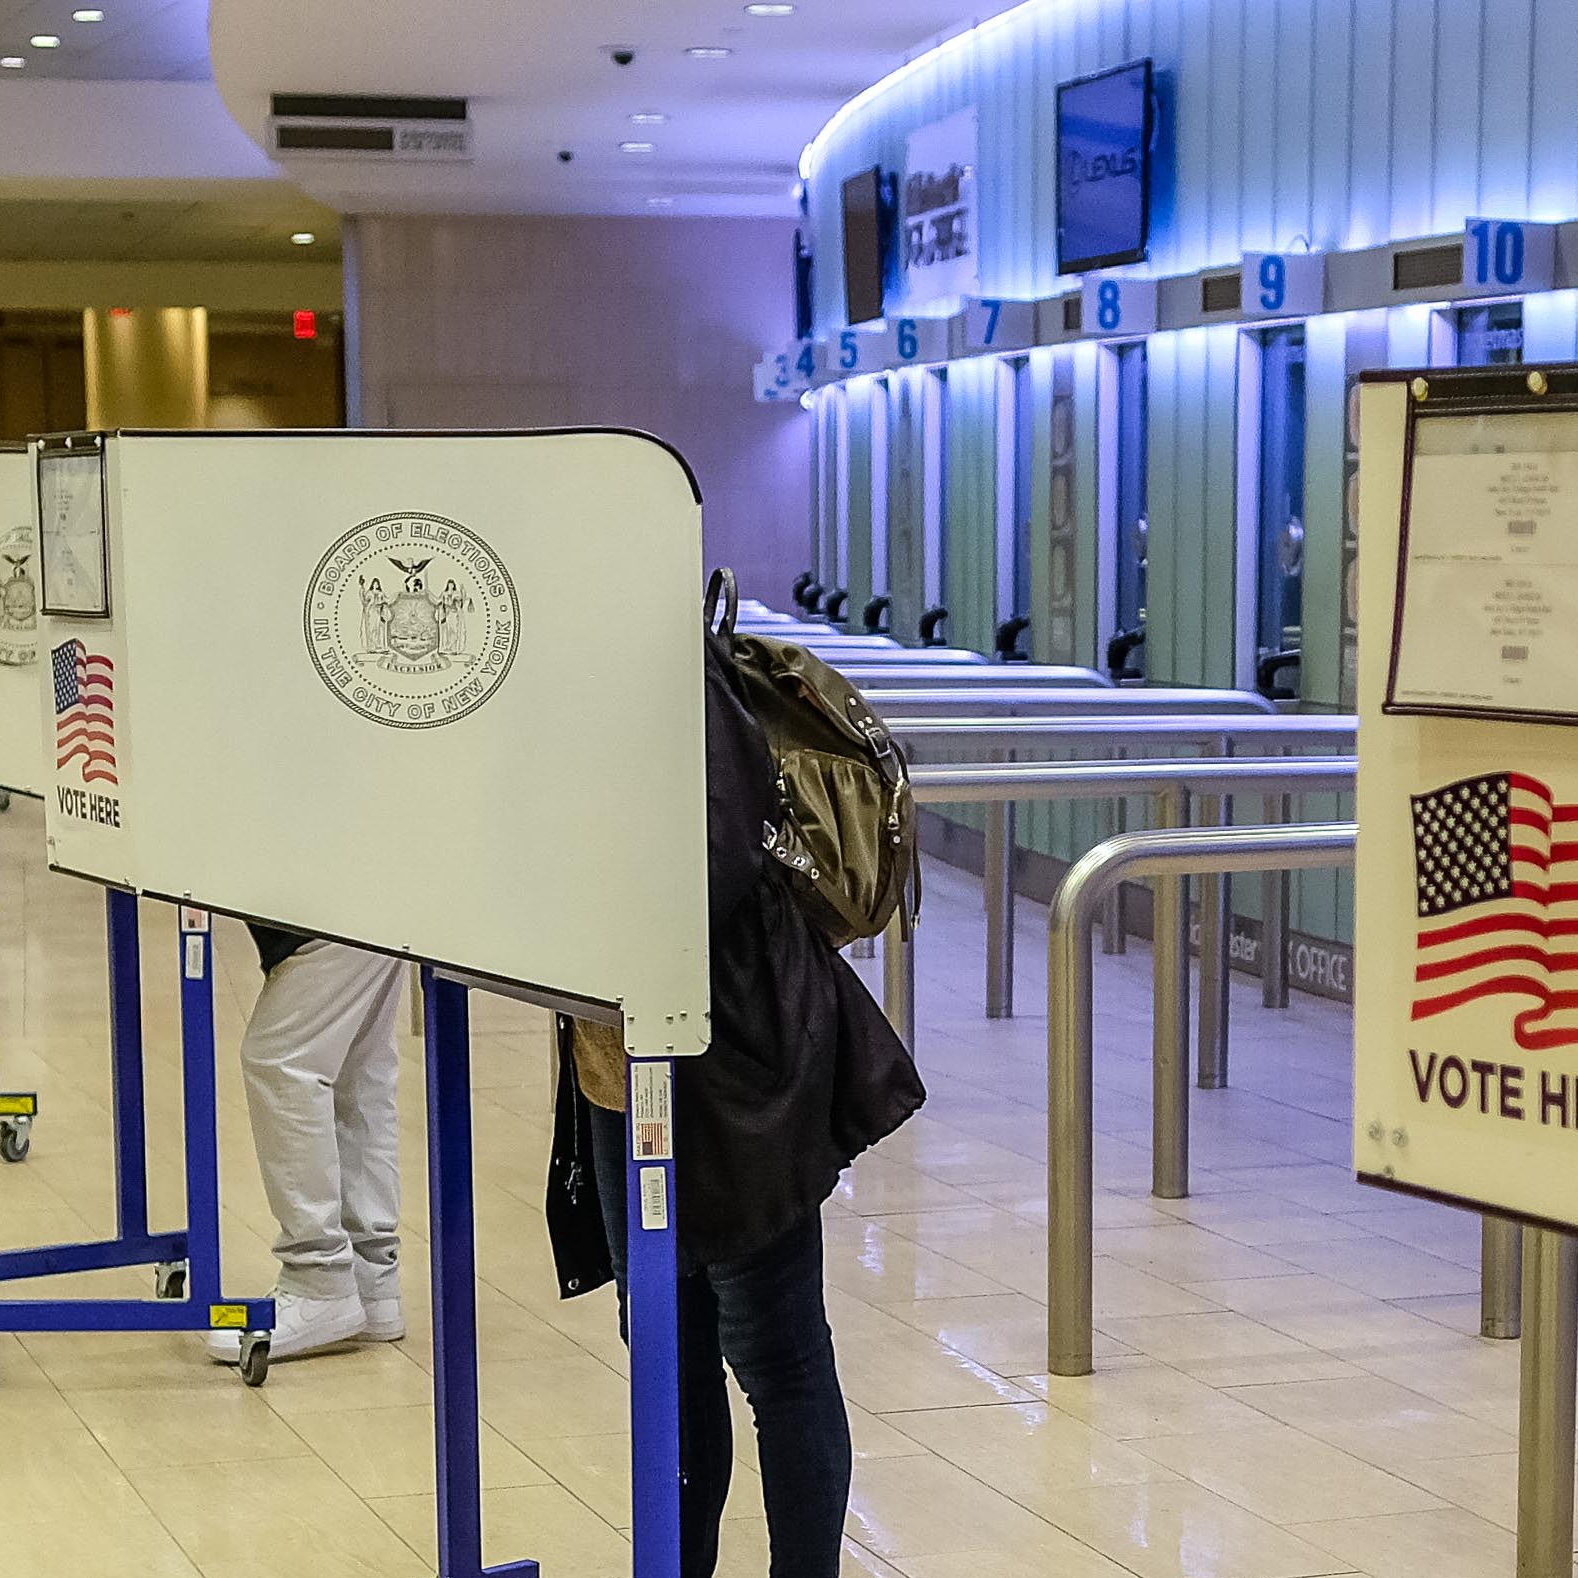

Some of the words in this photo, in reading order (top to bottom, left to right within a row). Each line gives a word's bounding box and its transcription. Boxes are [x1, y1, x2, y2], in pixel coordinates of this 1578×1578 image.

[1471, 220, 1525, 285] 10
[1259, 255, 1287, 310] 9
[980, 299, 1002, 344] 7
[1097, 279, 1121, 330] 8
[839, 331, 858, 369] 5
[896, 318, 918, 360] 6
[796, 345, 815, 378] 4
[318, 535, 371, 596] BOARD
[375, 522, 403, 542] OF
[410, 522, 505, 598] ELECTIONS
[314, 618, 331, 642] IN
[480, 619, 512, 677] YORK
[321, 647, 353, 688] THE
[385, 662, 443, 673] EXCELSIOR
[352, 686, 401, 717] CITY
[407, 703, 436, 720] OF
[441, 678, 484, 714] NEW
[56, 785, 88, 820] VOTE
[89, 792, 121, 829] HERE
[1409, 1049, 1525, 1121] VOTE
